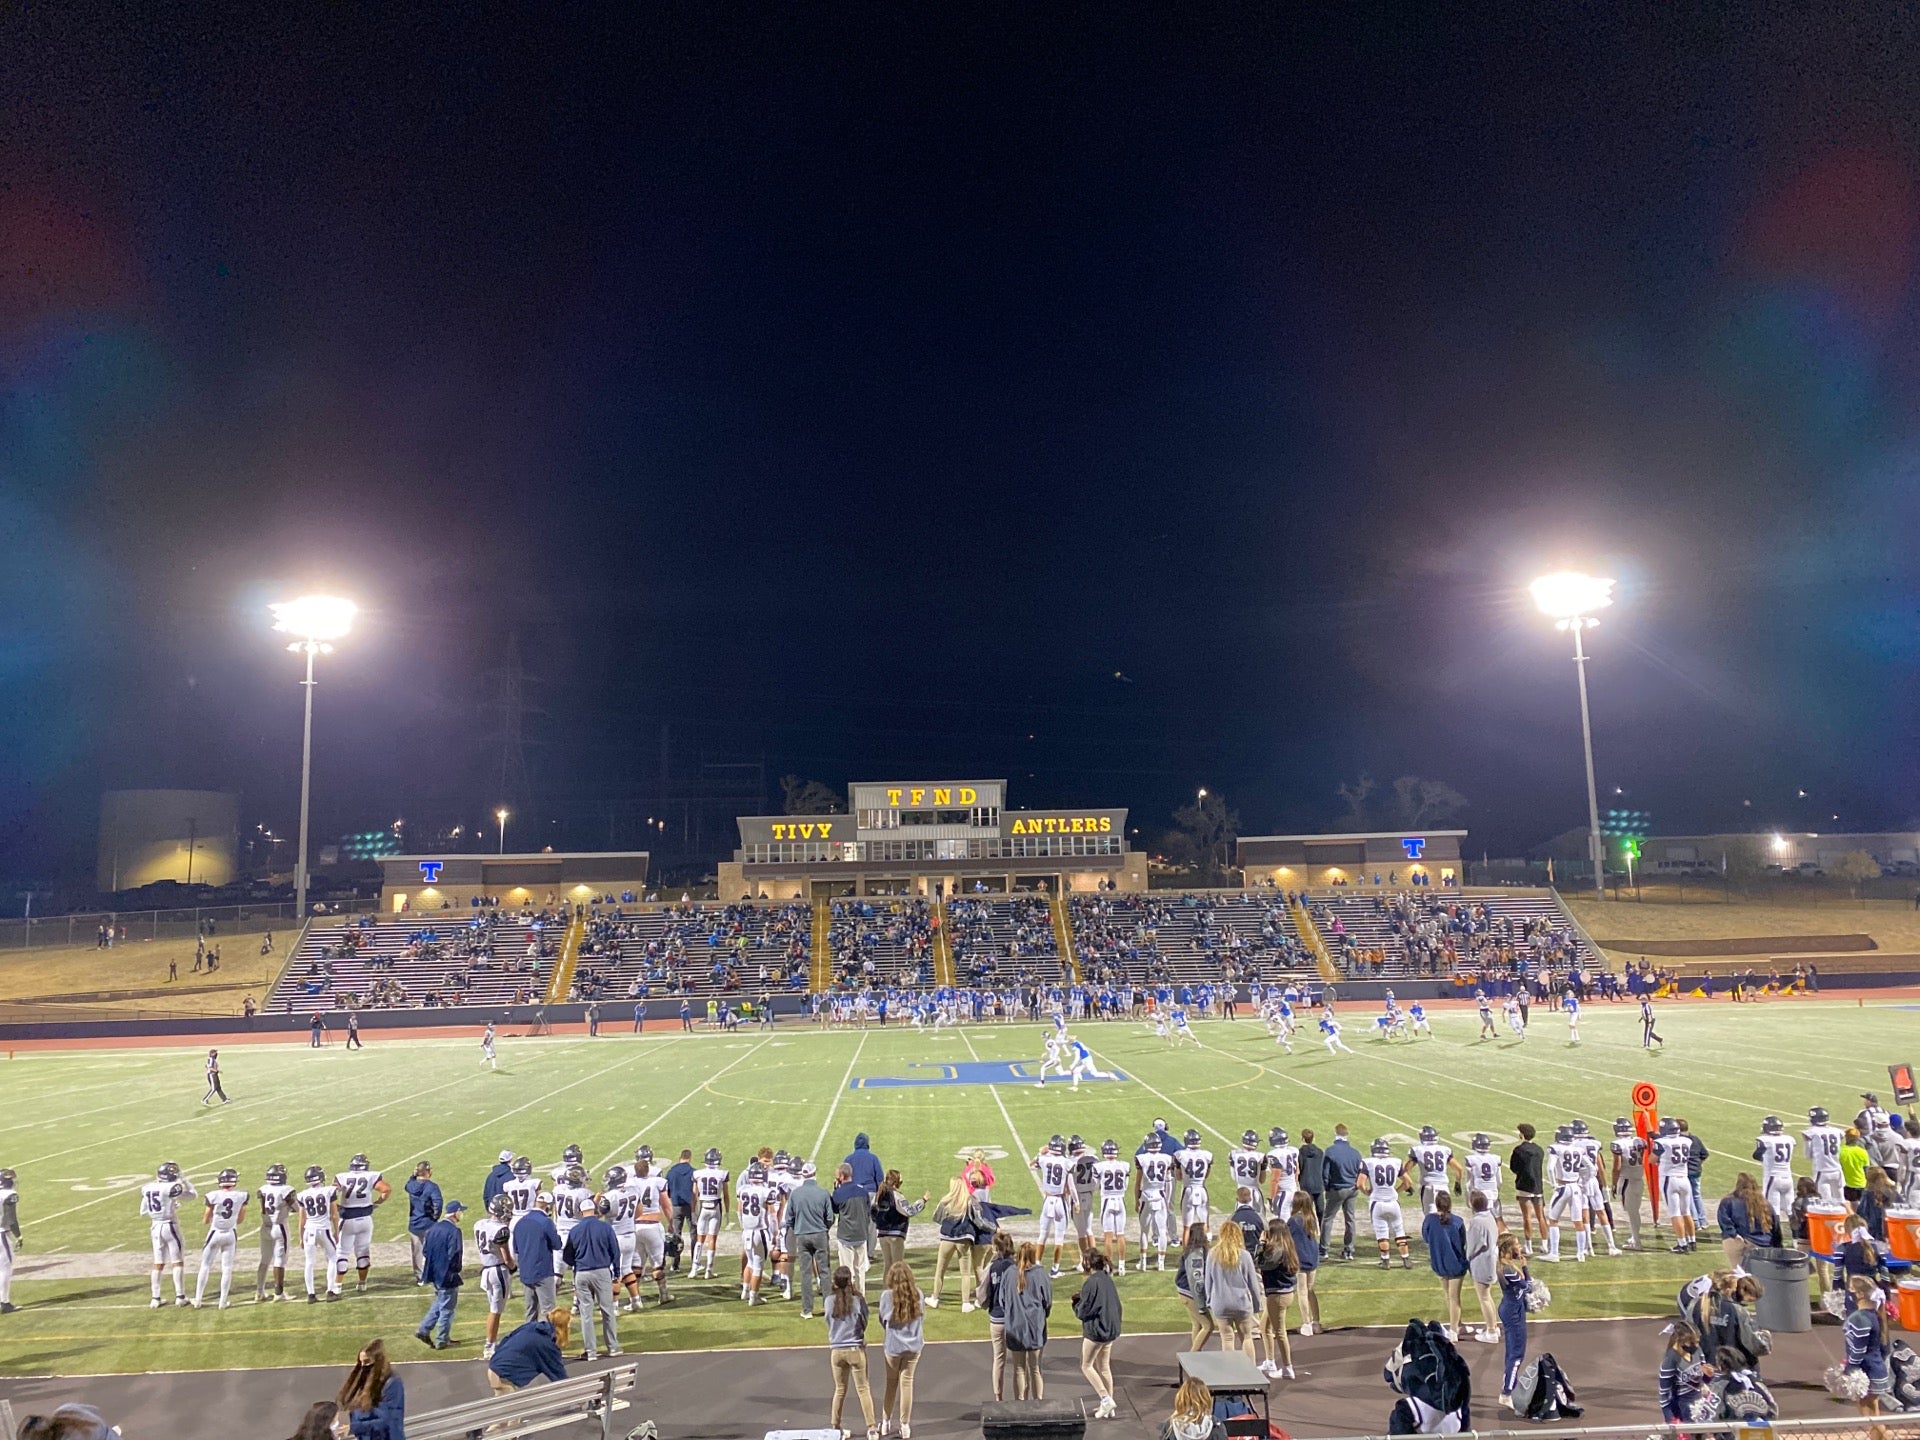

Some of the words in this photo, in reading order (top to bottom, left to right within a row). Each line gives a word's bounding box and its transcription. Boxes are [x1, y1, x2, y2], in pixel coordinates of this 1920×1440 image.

[887, 788, 977, 806] TFND
[772, 823, 833, 840] TIVY
[1012, 817, 1112, 834] ANTLERS
[1402, 838, 1426, 858] T
[419, 861, 443, 883] T
[1775, 1143, 1791, 1163] 51
[1821, 1134, 1838, 1155] 18
[1146, 1160, 1167, 1182] 43
[1185, 1158, 1205, 1178] 42
[1236, 1156, 1258, 1178] 29
[1424, 1151, 1444, 1172] 66
[1562, 1151, 1581, 1172] 82
[1046, 1163, 1063, 1186] 19
[1104, 1171, 1124, 1190] 26
[1374, 1165, 1395, 1186] 60
[346, 1177, 368, 1199] 72
[701, 1177, 718, 1195] 16
[146, 1191, 162, 1212] 15
[222, 1198, 234, 1219] 3
[305, 1193, 326, 1216] 88
[511, 1189, 529, 1210] 17
[557, 1194, 573, 1218] 79
[616, 1195, 636, 1221] 75
[741, 1193, 760, 1216] 28
